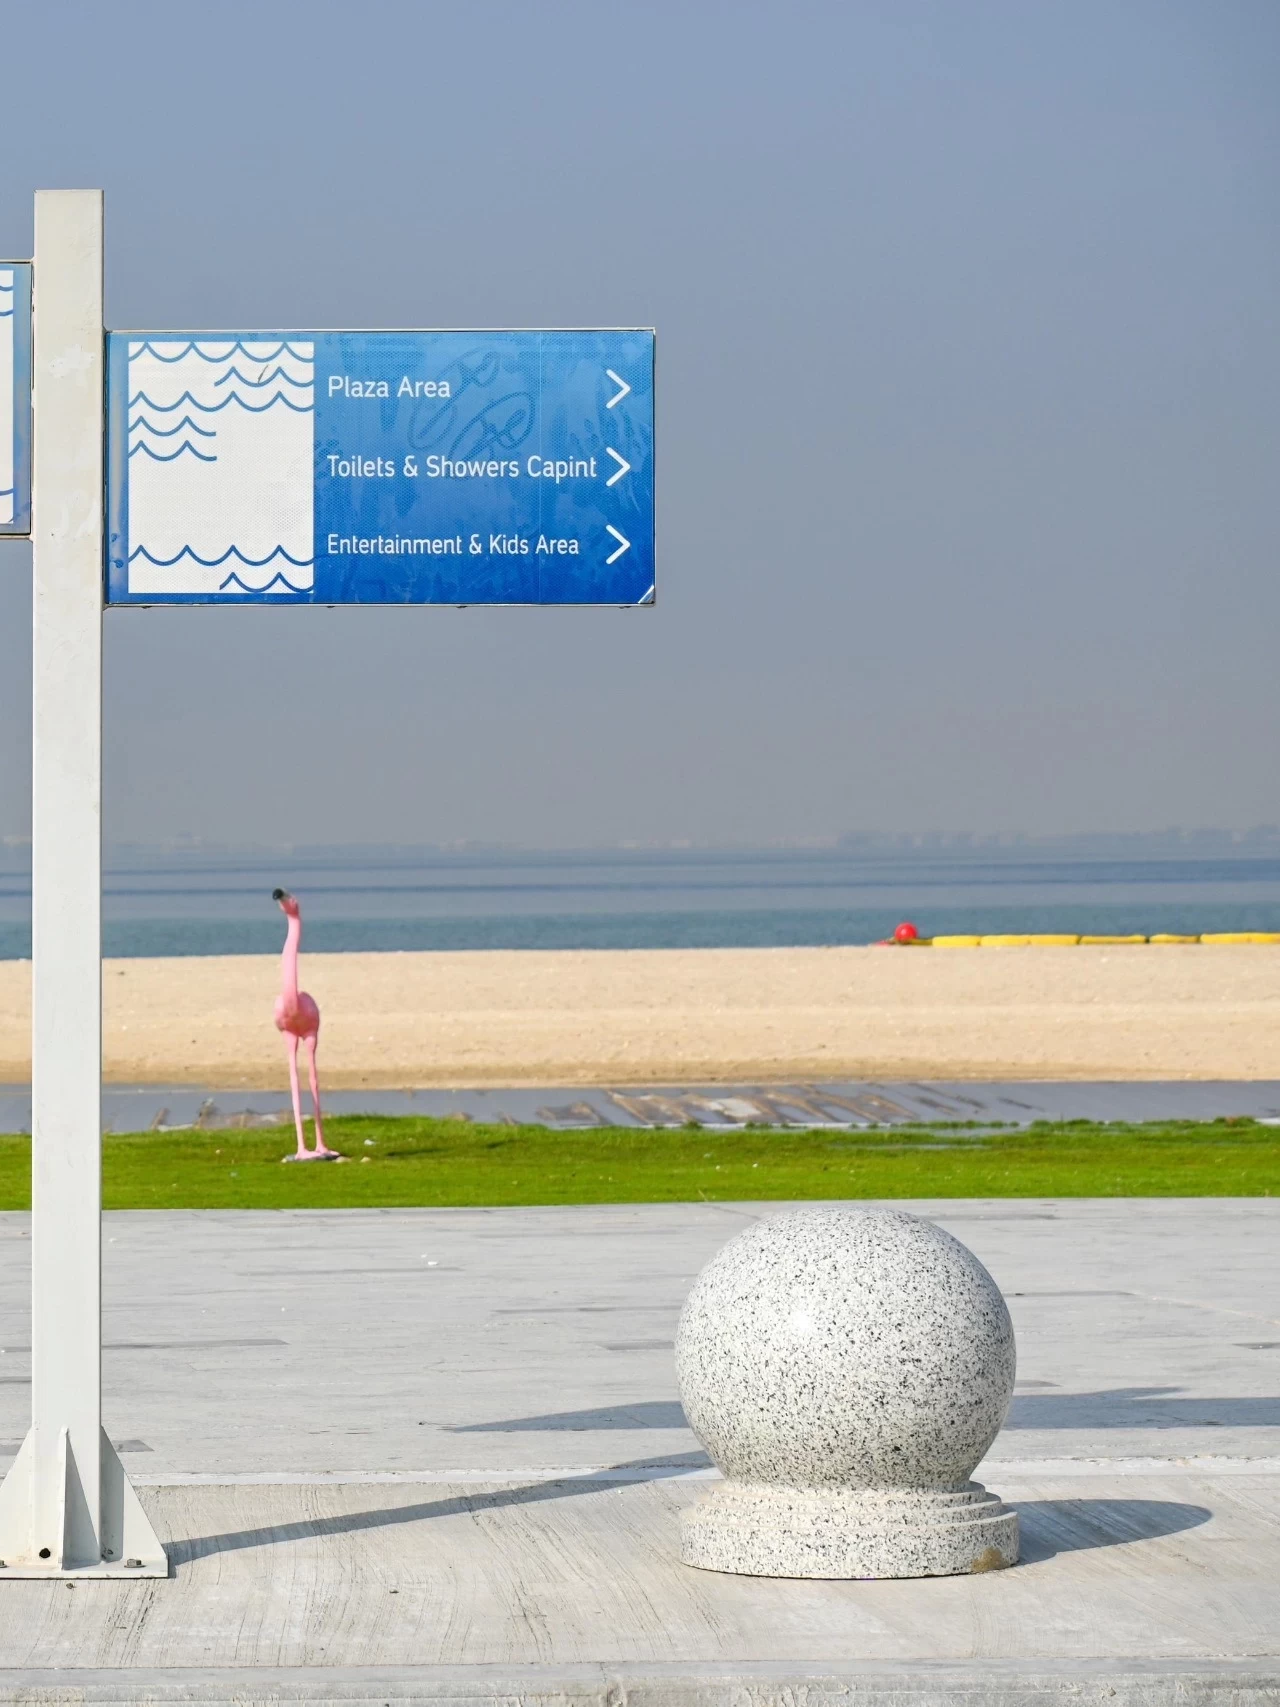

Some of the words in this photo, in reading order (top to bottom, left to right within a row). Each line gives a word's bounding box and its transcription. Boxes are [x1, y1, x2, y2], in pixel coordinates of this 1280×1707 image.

[328, 375, 389, 398] Plaza
[397, 375, 451, 398] Area
[326, 454, 395, 478] Toilets
[402, 454, 419, 478] &
[426, 454, 520, 478] Showers
[527, 454, 597, 485] Capint
[327, 533, 462, 555] Entertainment
[468, 533, 483, 555] &
[489, 533, 529, 555] Kids
[535, 533, 580, 555] Area
